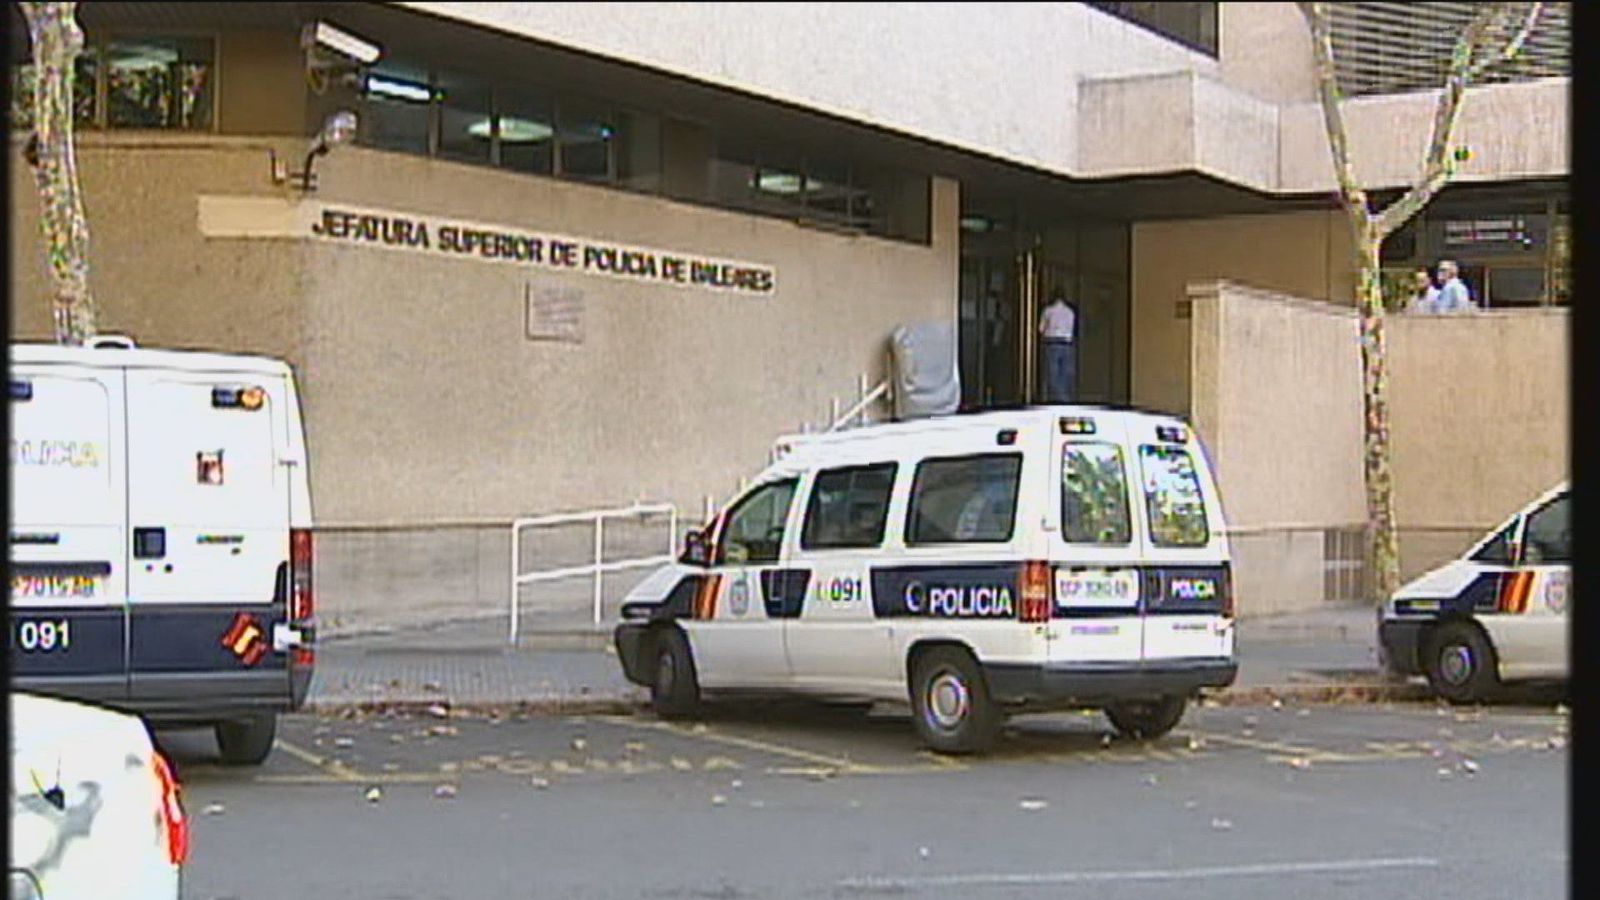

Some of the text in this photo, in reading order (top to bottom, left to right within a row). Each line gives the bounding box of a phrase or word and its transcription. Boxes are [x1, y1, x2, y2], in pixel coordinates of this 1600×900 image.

[312, 211, 429, 249] JEFATURA
[439, 227, 543, 263] SUPERIOR
[550, 240, 577, 267] DE
[584, 246, 656, 278] POLICIA
[662, 258, 687, 283] DE
[929, 588, 1012, 616] POLICIA
[1171, 578, 1216, 600] POLICIA
[20, 621, 70, 650] 091
